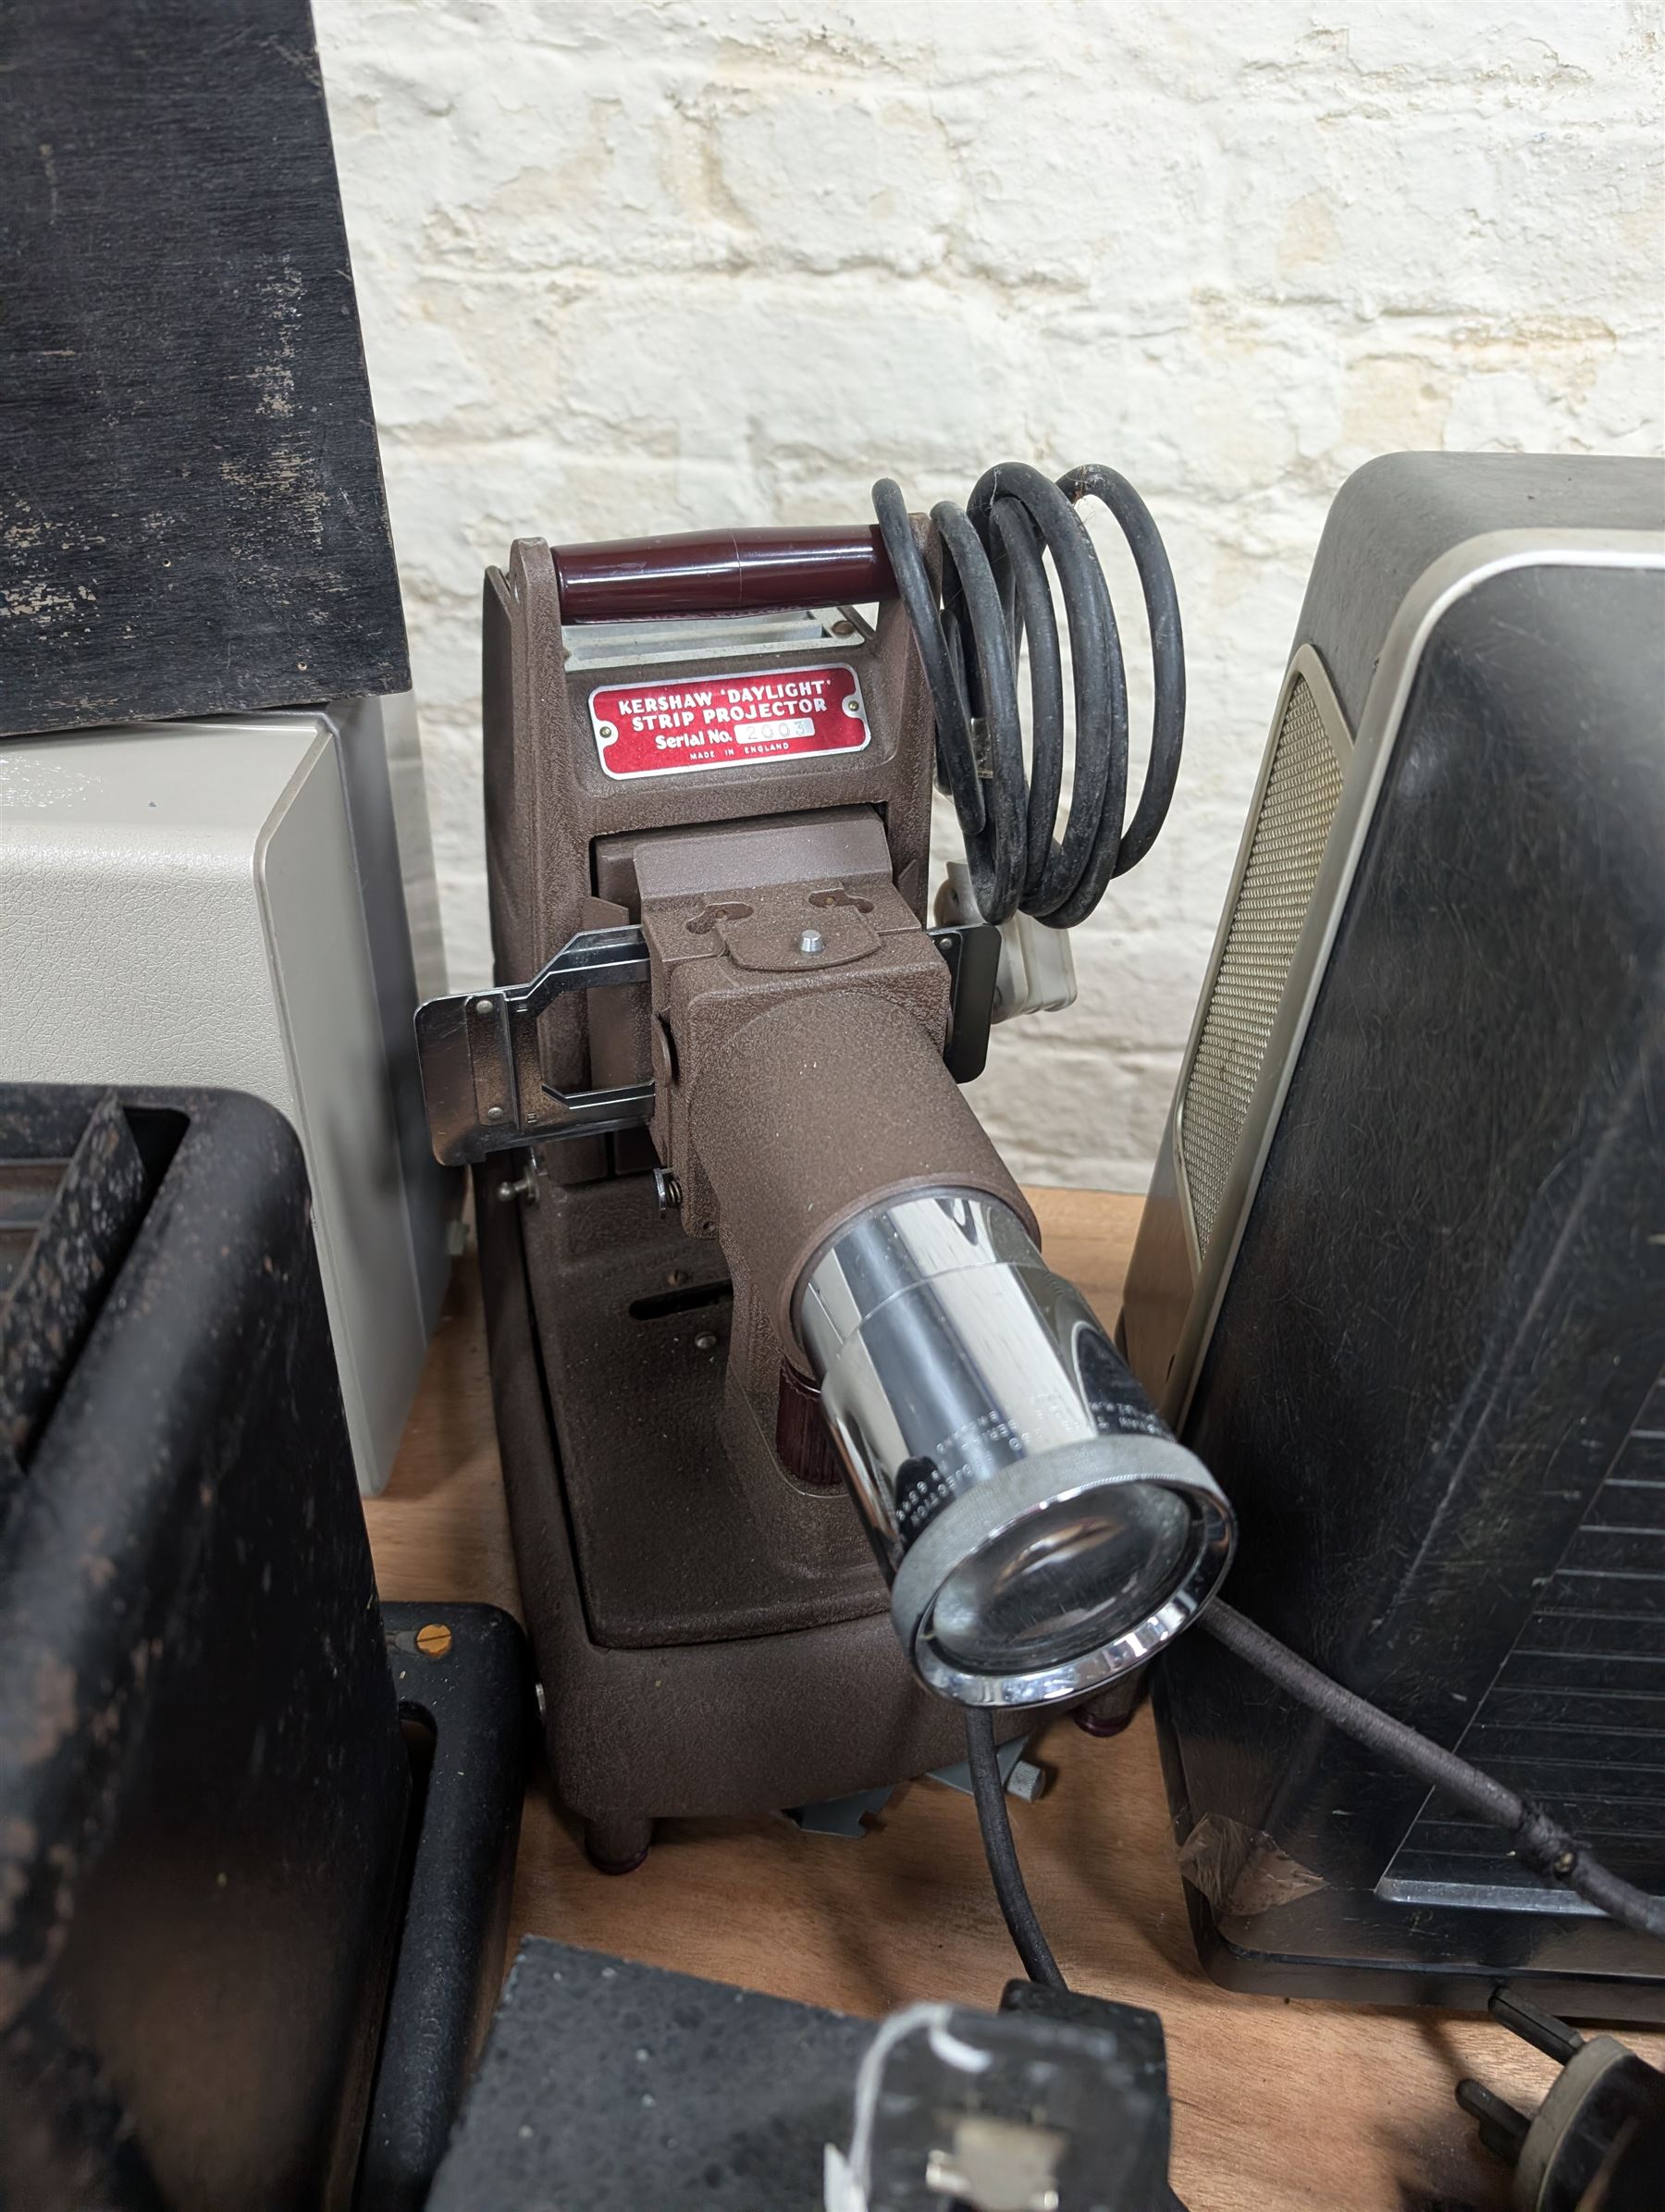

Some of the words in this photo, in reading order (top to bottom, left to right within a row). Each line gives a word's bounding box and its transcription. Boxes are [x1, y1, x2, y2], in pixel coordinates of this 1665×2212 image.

[618, 691, 713, 715] KERSHAW
[632, 711, 696, 732] STRIP
[703, 698, 827, 724] PROJECTOR
[655, 731, 705, 750] Serial
[709, 729, 734, 744] No.
[689, 750, 715, 760] MADE
[744, 742, 789, 754] ENGLAND
